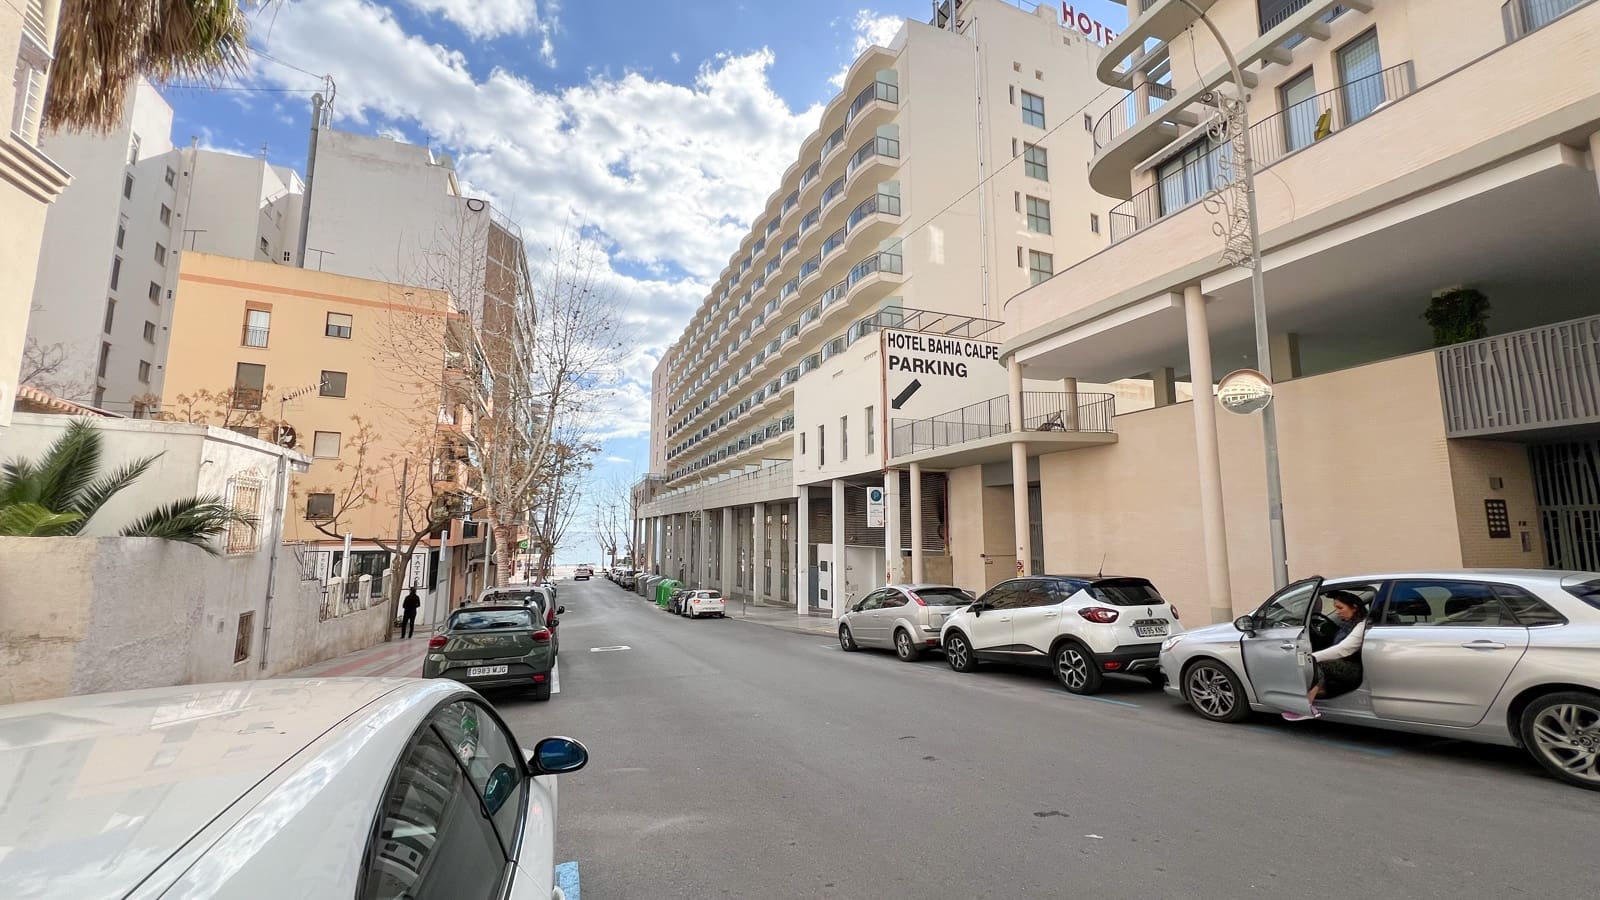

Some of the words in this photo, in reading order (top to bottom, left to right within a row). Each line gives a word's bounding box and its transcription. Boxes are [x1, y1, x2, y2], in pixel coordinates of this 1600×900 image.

[1062, 1, 1119, 46] HOTE
[888, 333, 926, 352] HOTEL
[928, 338, 962, 356] BAHIA
[965, 343, 999, 361] CALPE
[889, 355, 968, 378] PARKING
